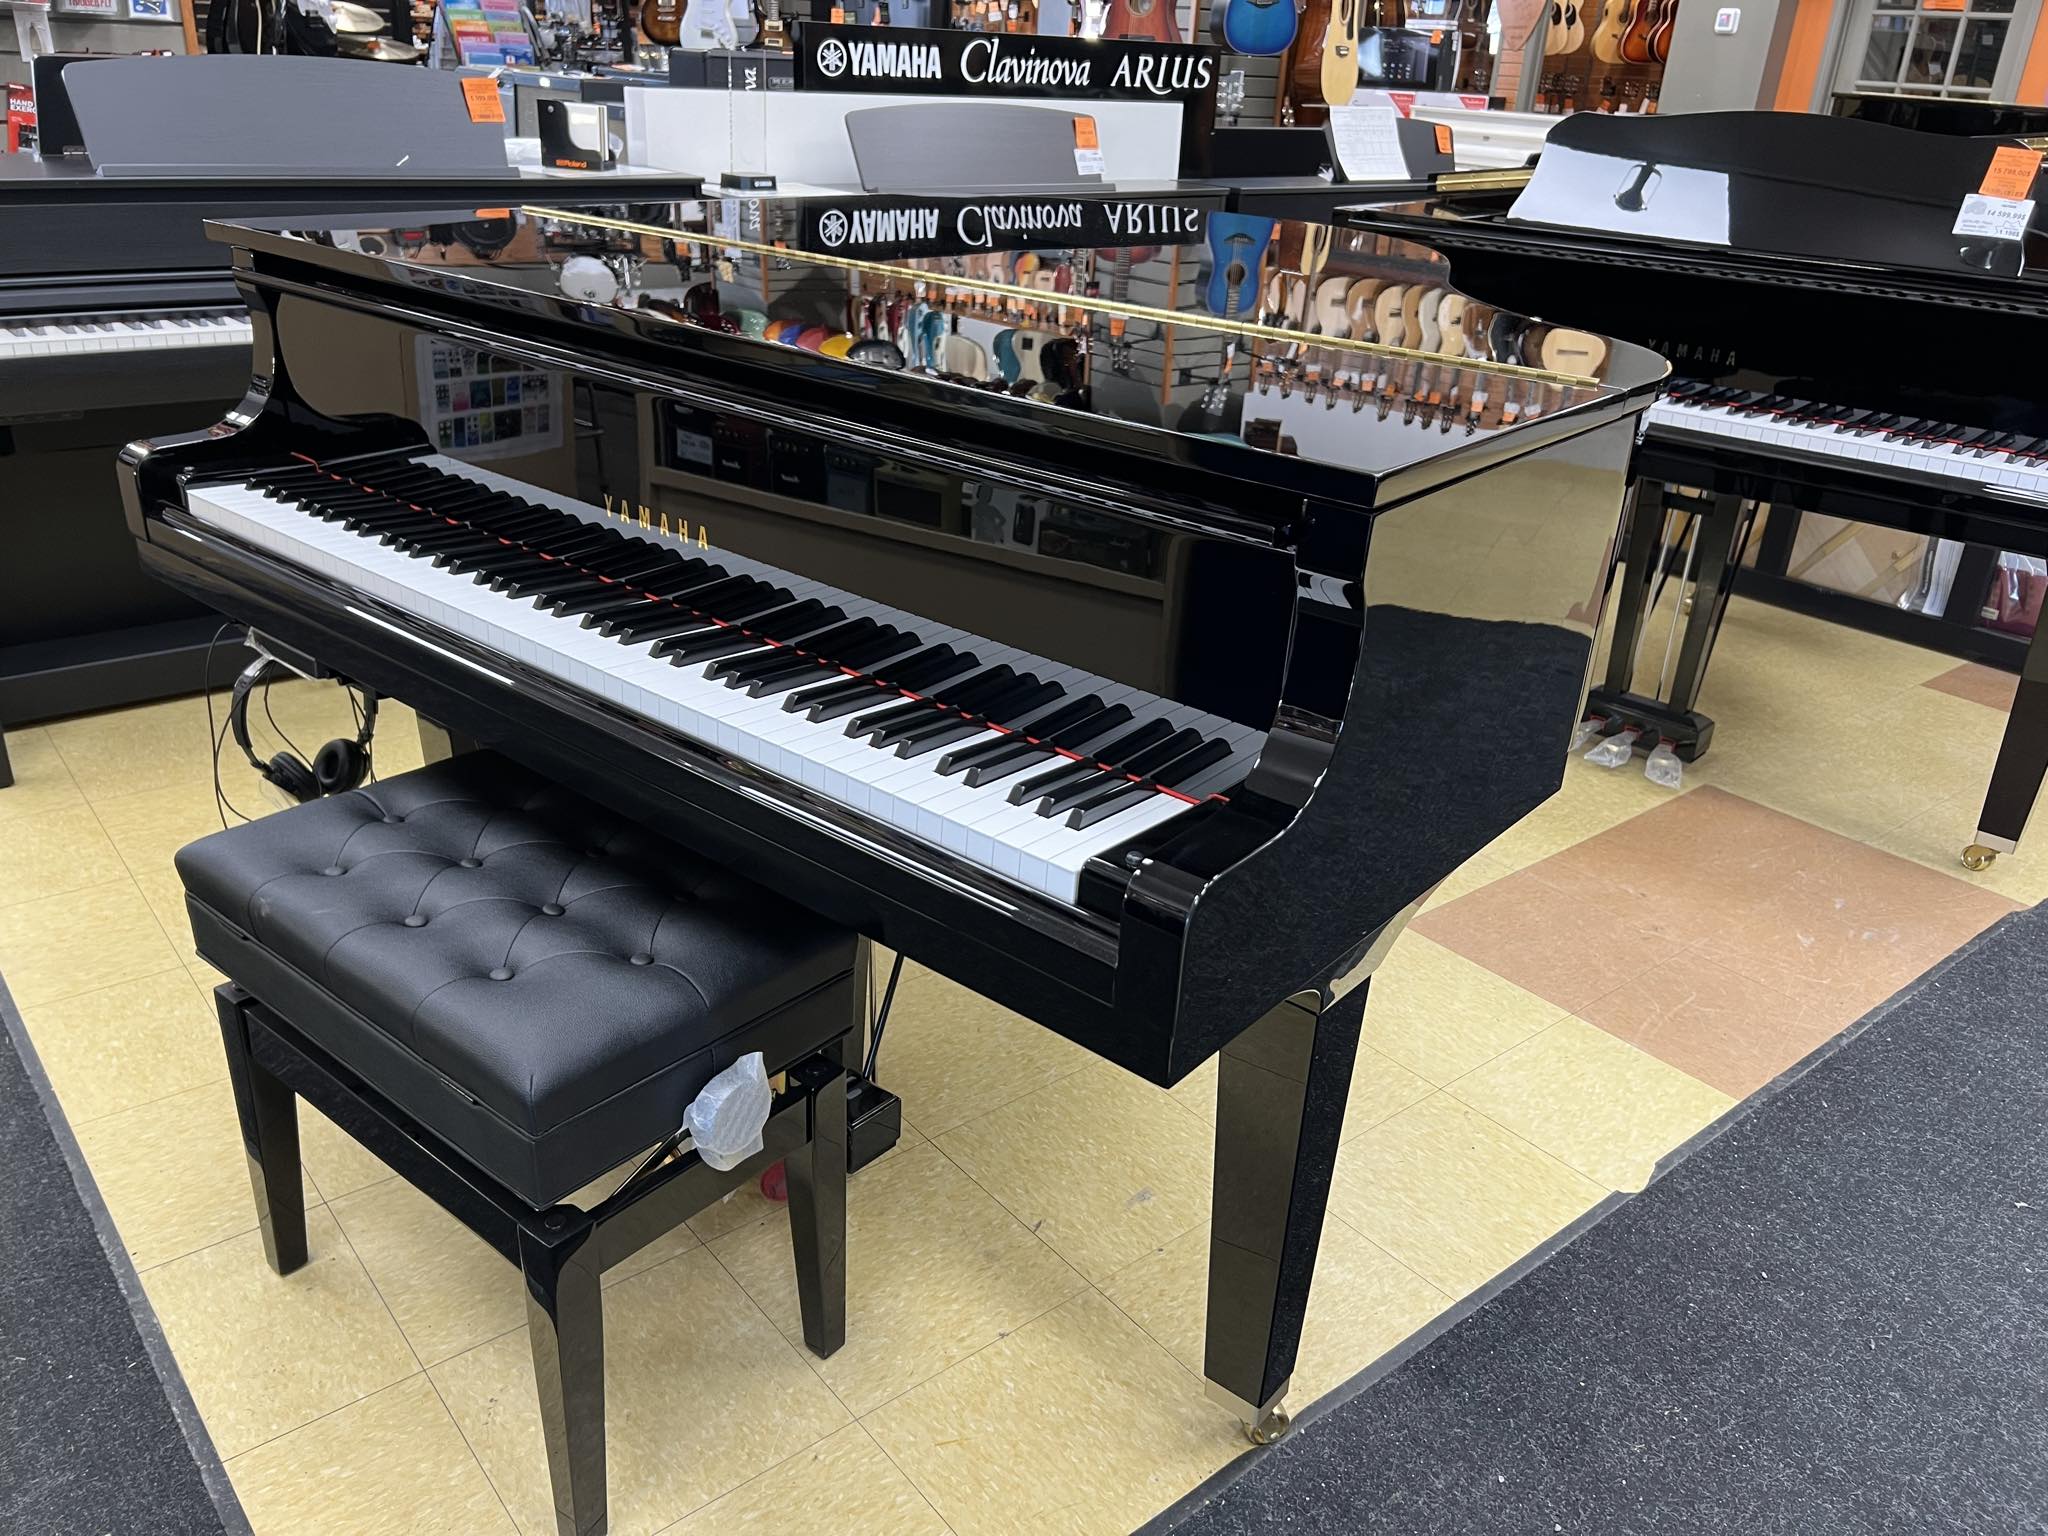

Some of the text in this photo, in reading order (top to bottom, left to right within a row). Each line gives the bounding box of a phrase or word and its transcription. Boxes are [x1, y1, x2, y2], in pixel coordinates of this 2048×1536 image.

[848, 39, 1213, 95] YAMAHA Clavinova ARIUS
[9, 98, 34, 107] HAND
[1648, 338, 1736, 367] YAMAHA
[603, 493, 709, 551] YAMAHA
